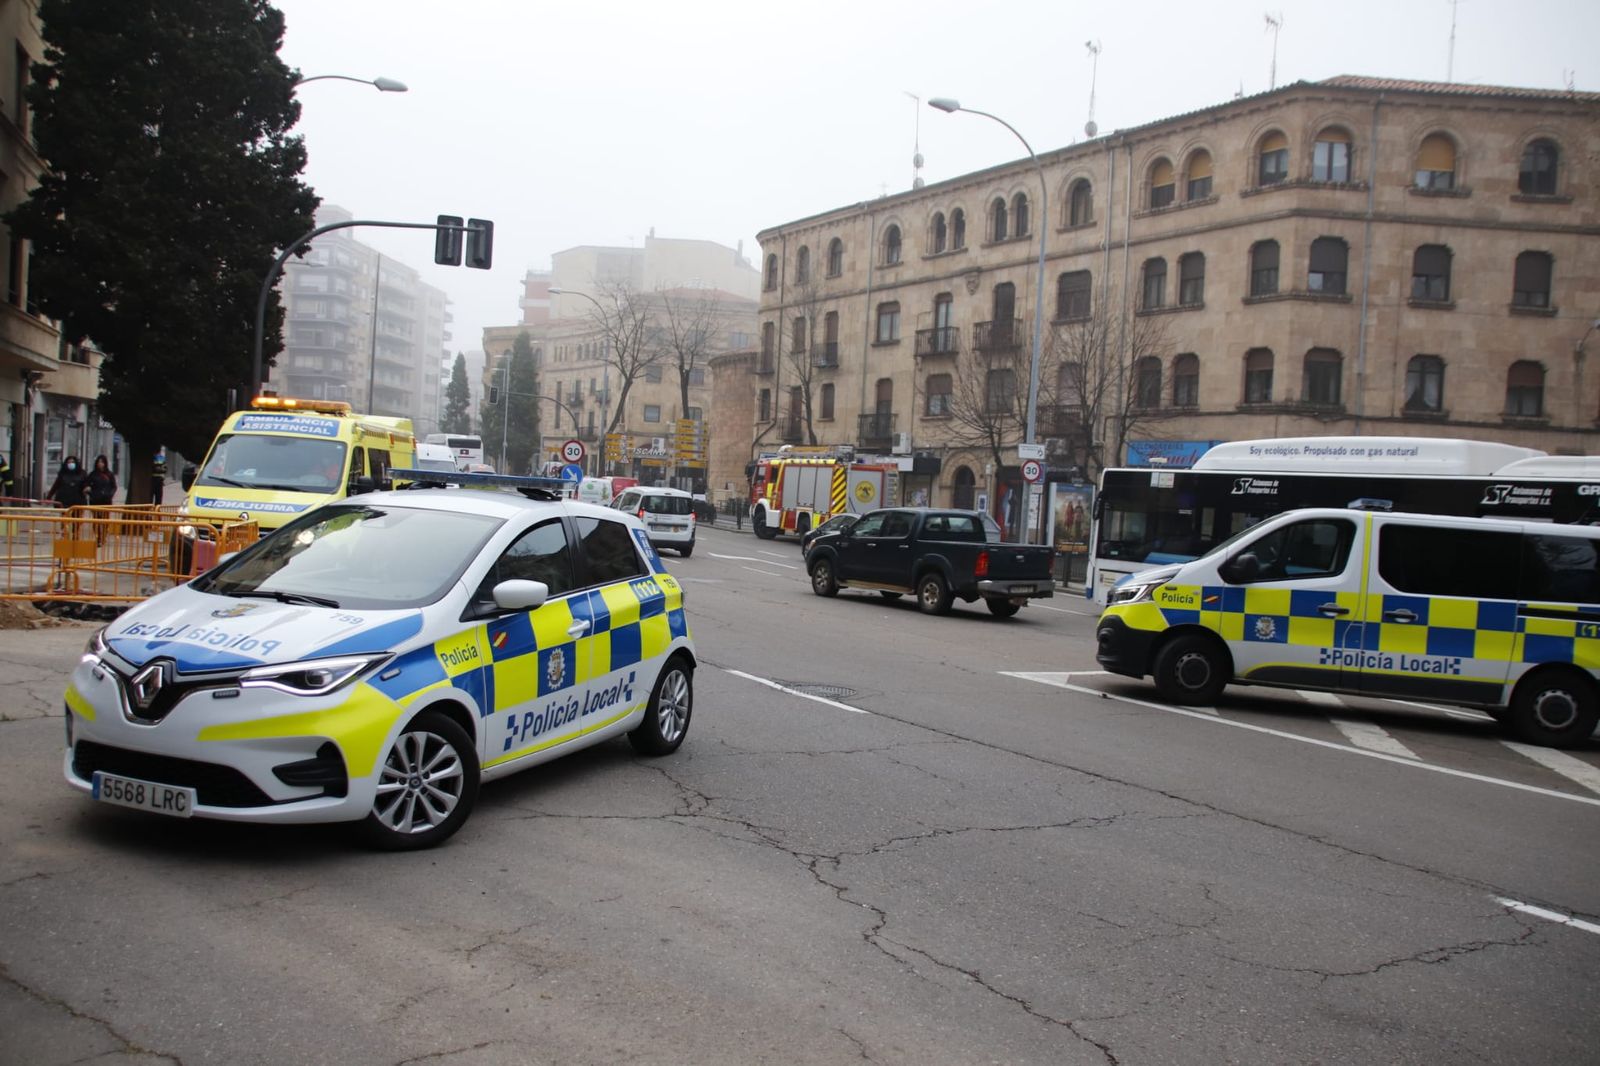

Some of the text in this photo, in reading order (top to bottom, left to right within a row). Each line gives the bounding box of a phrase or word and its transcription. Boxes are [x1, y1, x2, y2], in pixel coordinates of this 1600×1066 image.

[244, 415, 334, 427] AMBULANCIA
[242, 422, 331, 435] ASISTENCIAL
[567, 447, 580, 456] 30
[1249, 446, 1262, 456] Soy
[1303, 446, 1347, 456] Propulsado
[1350, 448, 1365, 456] con
[1368, 449, 1384, 457] gas
[1386, 446, 1419, 456] natural
[1025, 466, 1037, 475] 30
[1161, 592, 1194, 604] Policía
[329, 612, 364, 625] 759
[440, 643, 479, 668] Policía
[1332, 649, 1448, 674] Policía Local
[520, 677, 624, 742] Policía Local
[103, 778, 186, 812] 5568 LRC
